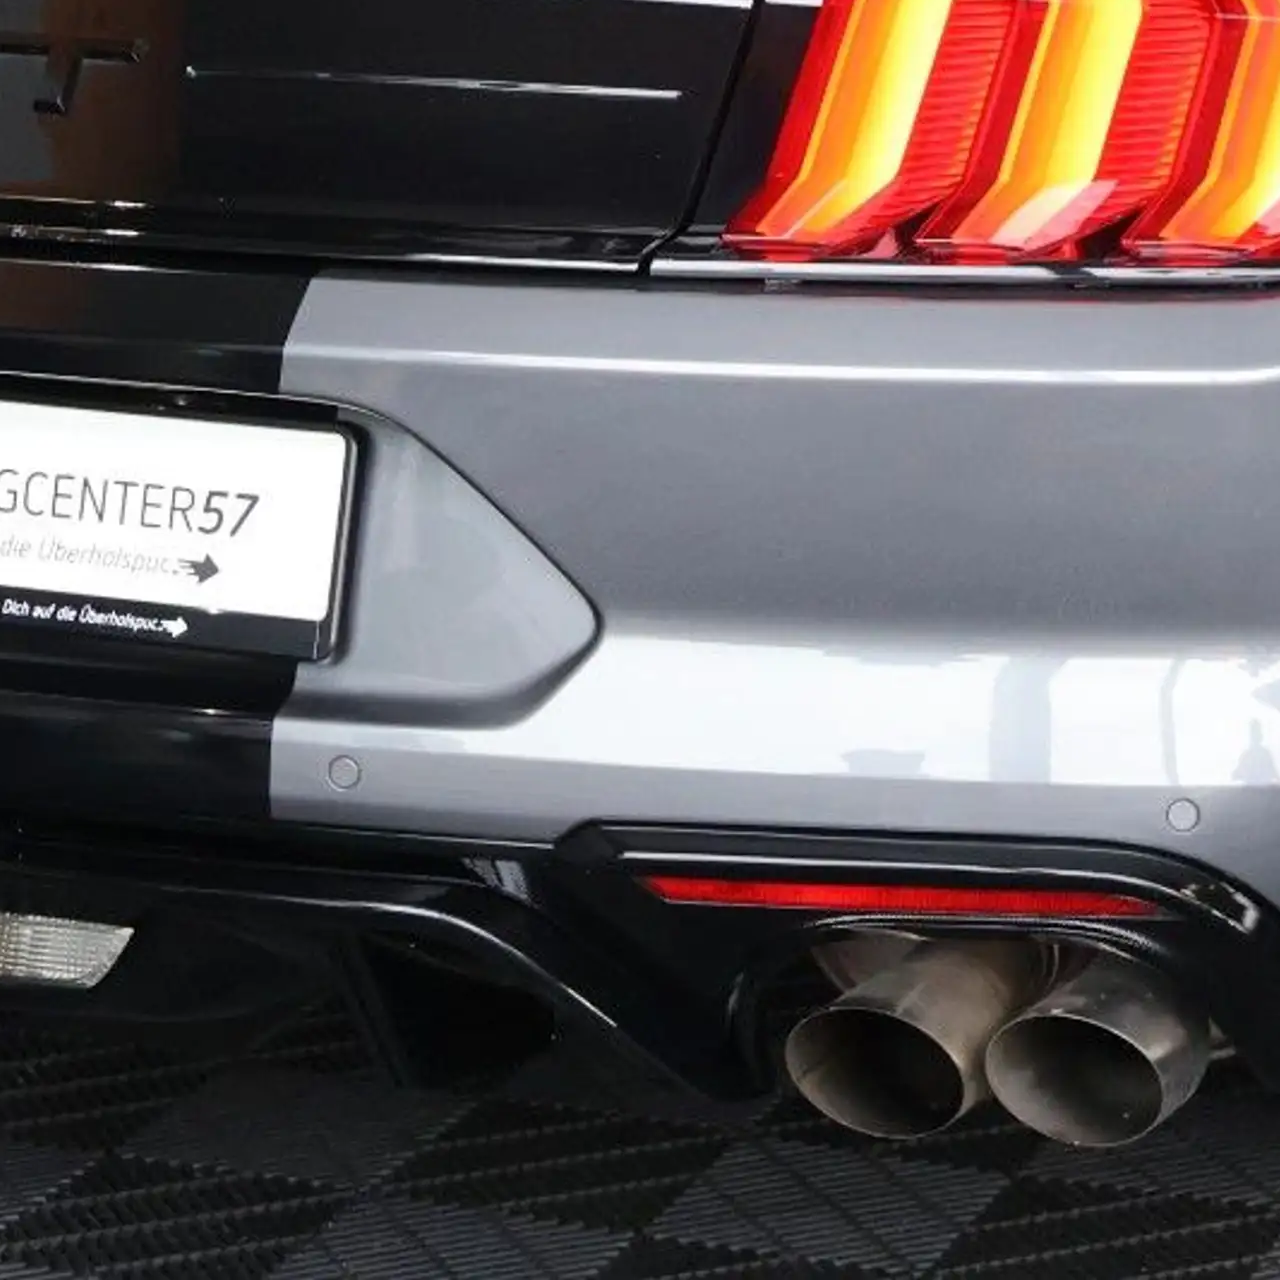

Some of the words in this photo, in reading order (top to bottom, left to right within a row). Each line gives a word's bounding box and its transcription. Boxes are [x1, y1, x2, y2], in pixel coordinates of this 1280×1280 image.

[0, 535, 31, 558] die
[1, 598, 30, 617] Dich
[32, 604, 55, 620] auf
[56, 605, 77, 622] die
